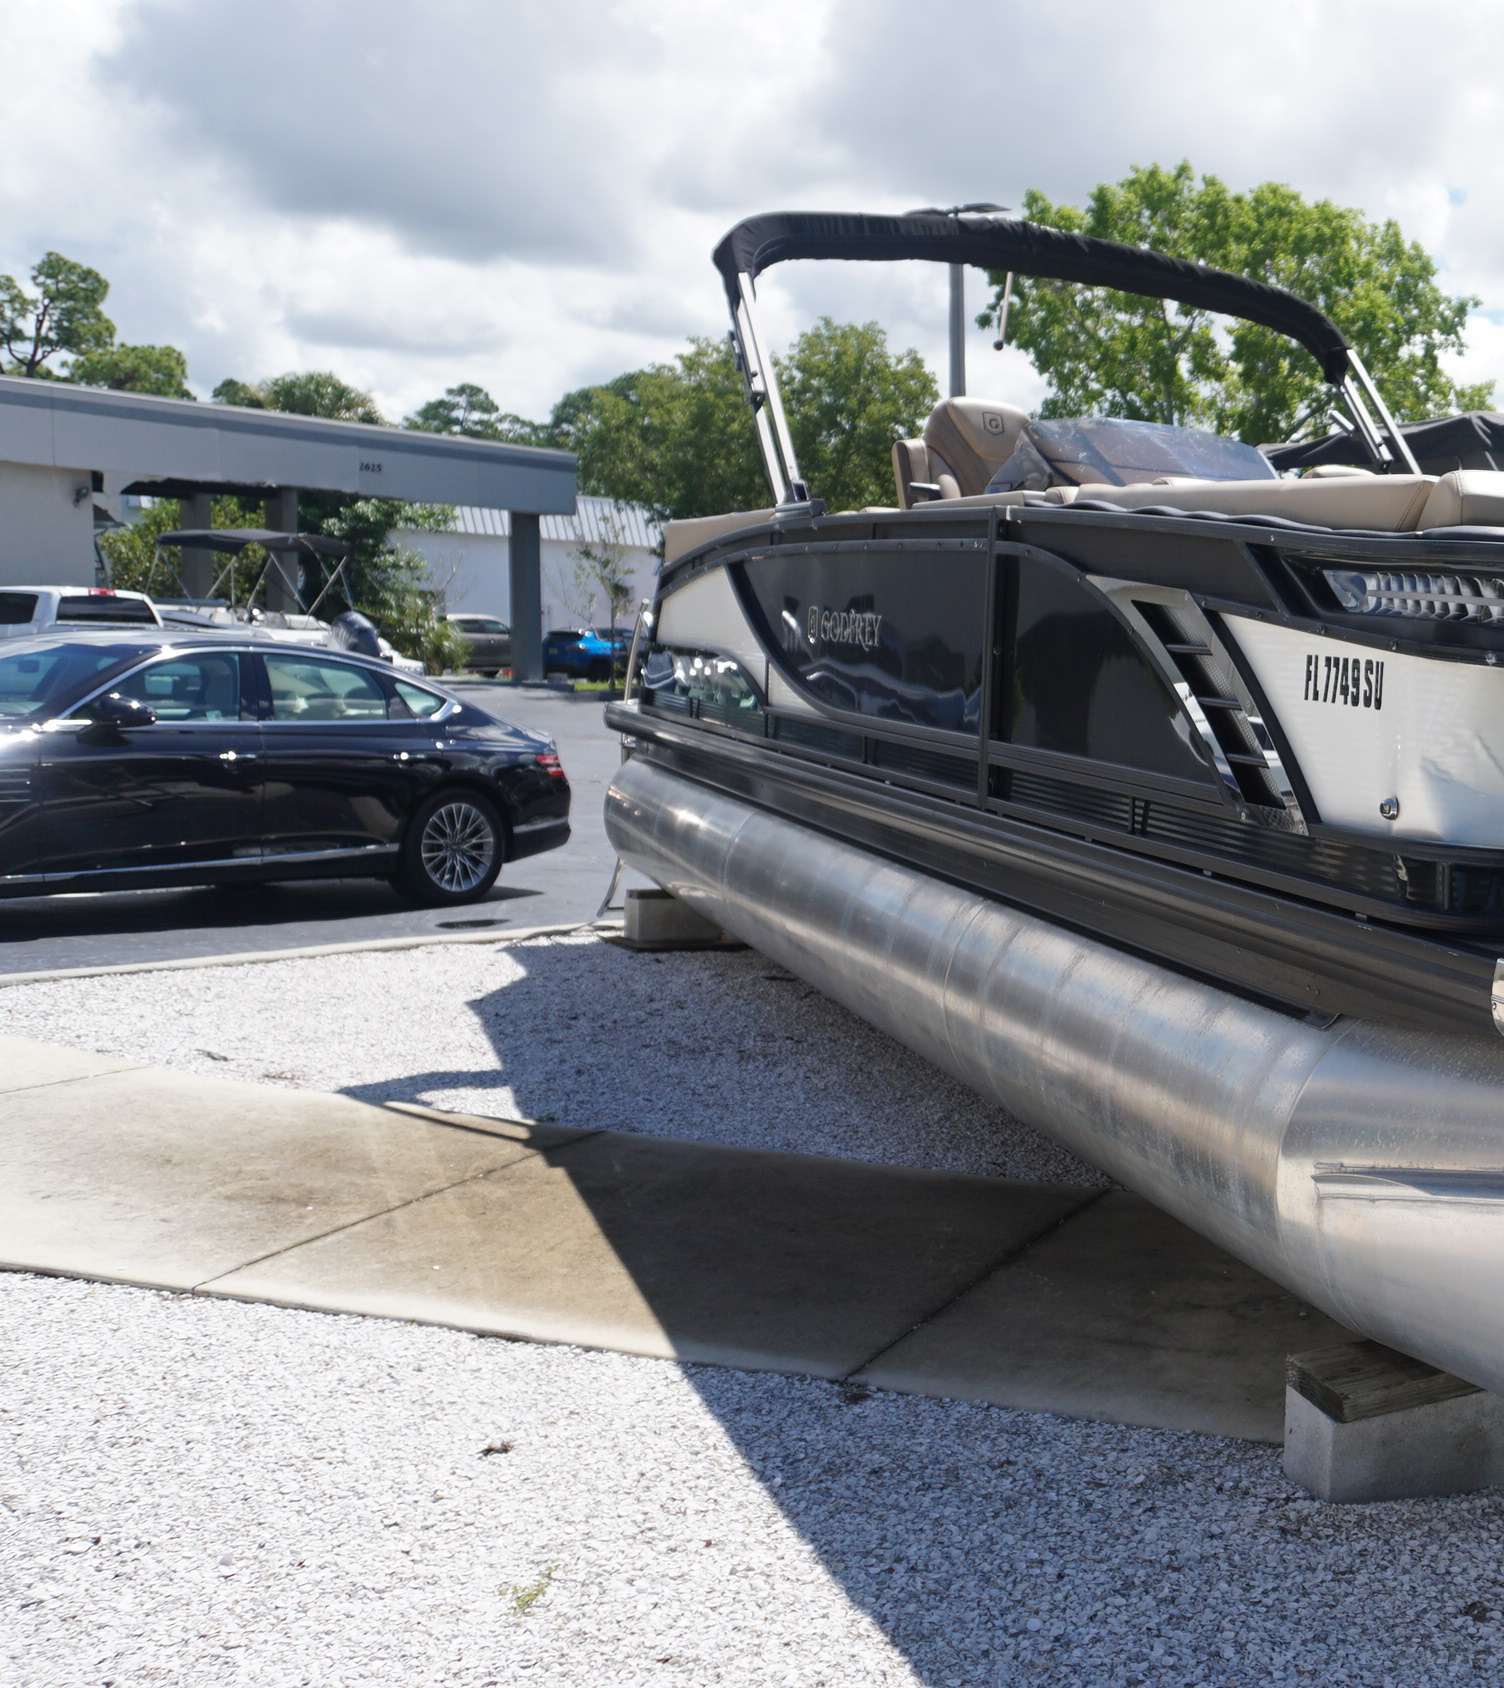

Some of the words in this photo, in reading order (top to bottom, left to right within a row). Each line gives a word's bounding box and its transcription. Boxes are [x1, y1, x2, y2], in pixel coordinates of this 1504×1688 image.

[821, 608, 882, 652] GODFREY
[1304, 655, 1319, 701] FL
[1323, 656, 1361, 707] 7749
[1363, 659, 1384, 711] SU
